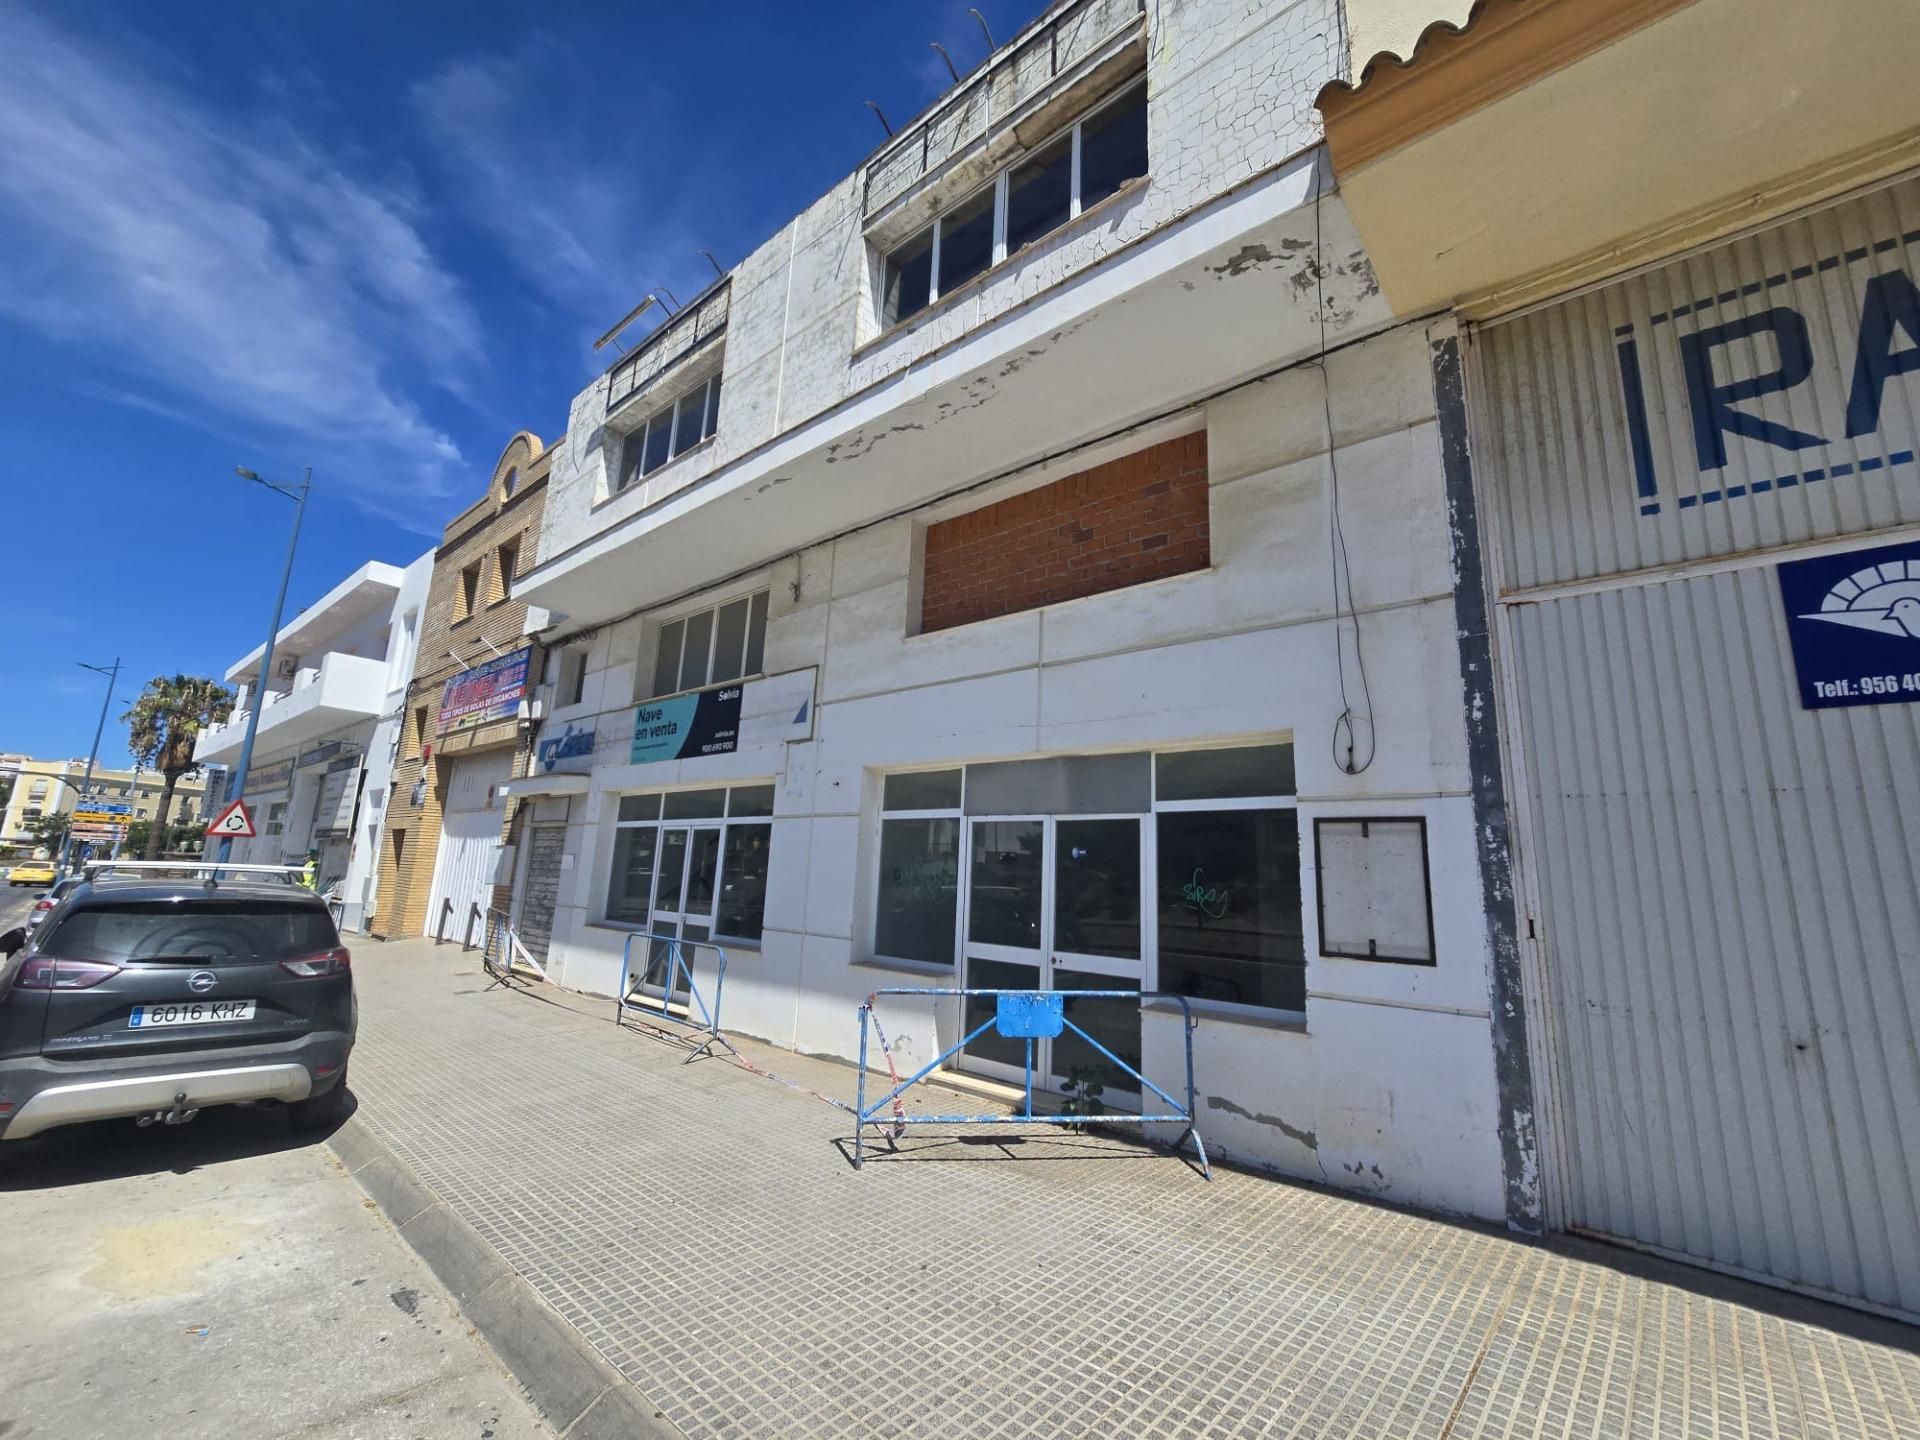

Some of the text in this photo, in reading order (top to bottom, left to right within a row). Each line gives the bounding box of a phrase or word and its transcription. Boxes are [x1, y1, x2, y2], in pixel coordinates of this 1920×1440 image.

[718, 688, 740, 702] Solvia
[1813, 679, 1859, 698] Telf.:
[1860, 675, 1899, 695] 956
[638, 708, 663, 724] Nave
[635, 720, 678, 740] en venta
[702, 745, 712, 753] 900
[723, 741, 734, 750] 900
[151, 1005, 202, 1024] 6016
[210, 1002, 249, 1019] KHZ
